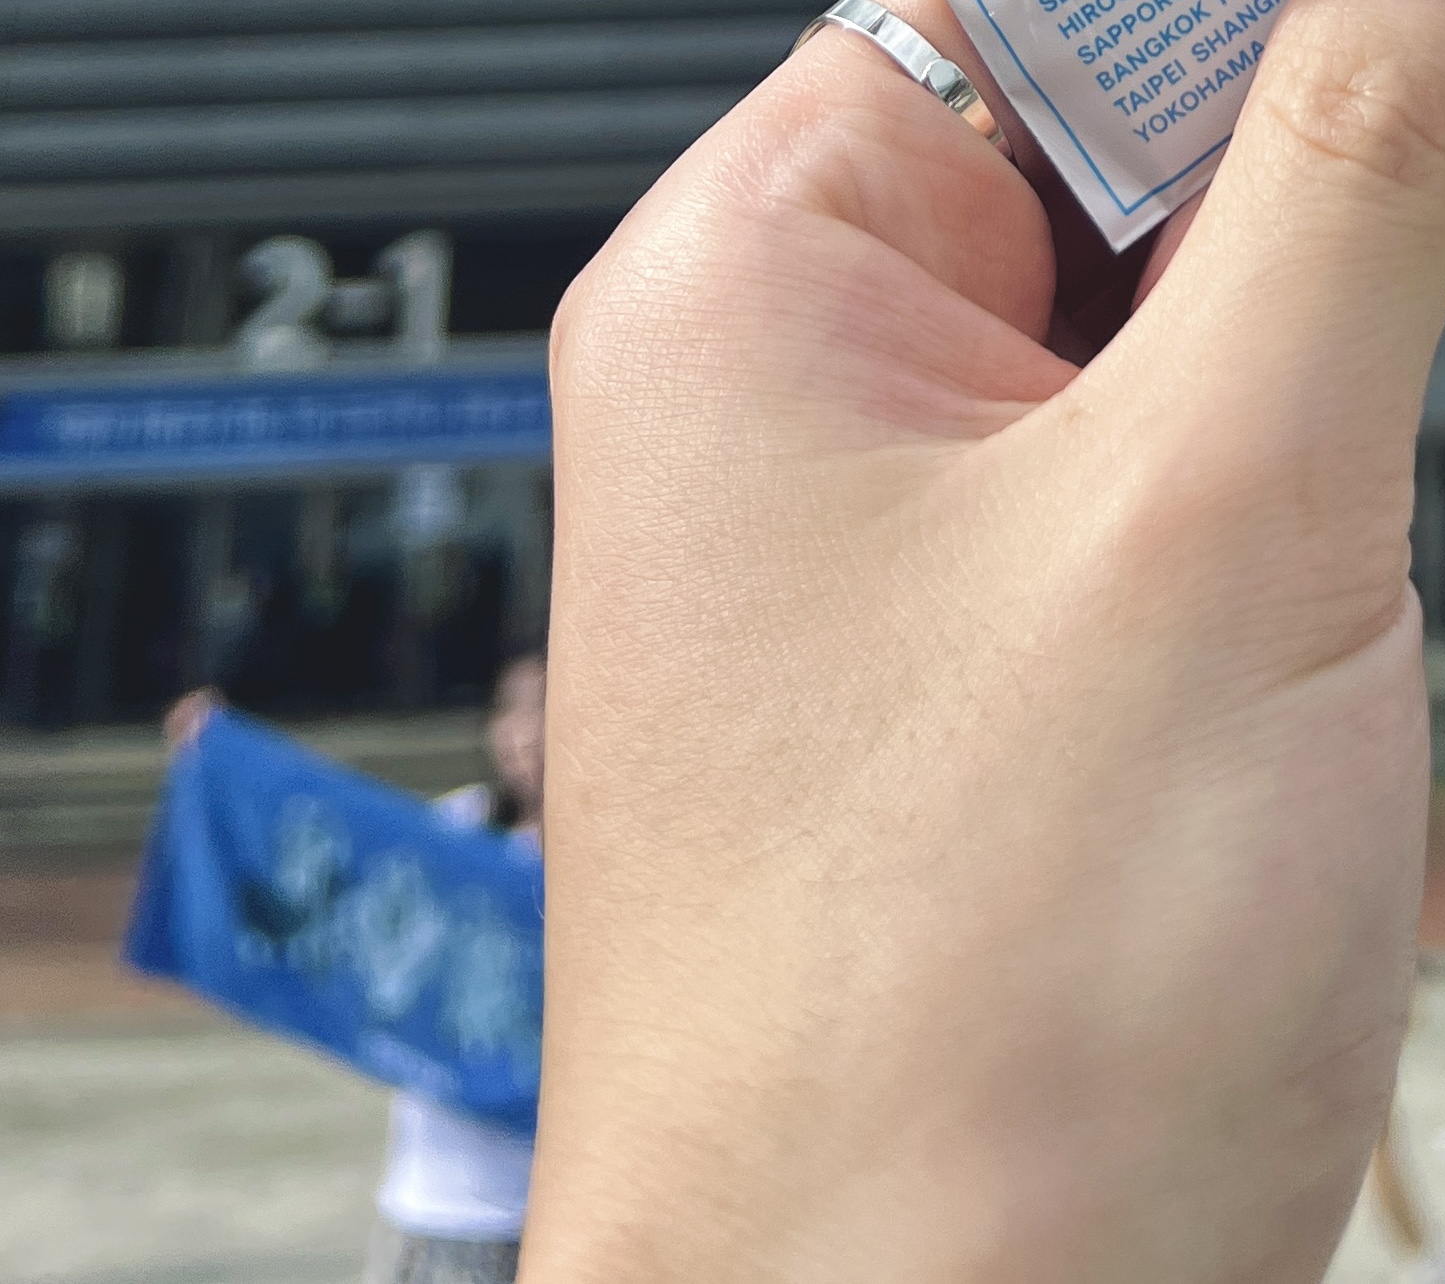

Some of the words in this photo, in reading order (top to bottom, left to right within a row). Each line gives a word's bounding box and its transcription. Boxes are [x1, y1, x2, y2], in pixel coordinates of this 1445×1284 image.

[1095, 0, 1211, 92] BANGKOK
[1113, 62, 1188, 117] TAIPEI
[1133, 40, 1265, 144] YOKOHAMA
[237, 232, 455, 370] 2-1
